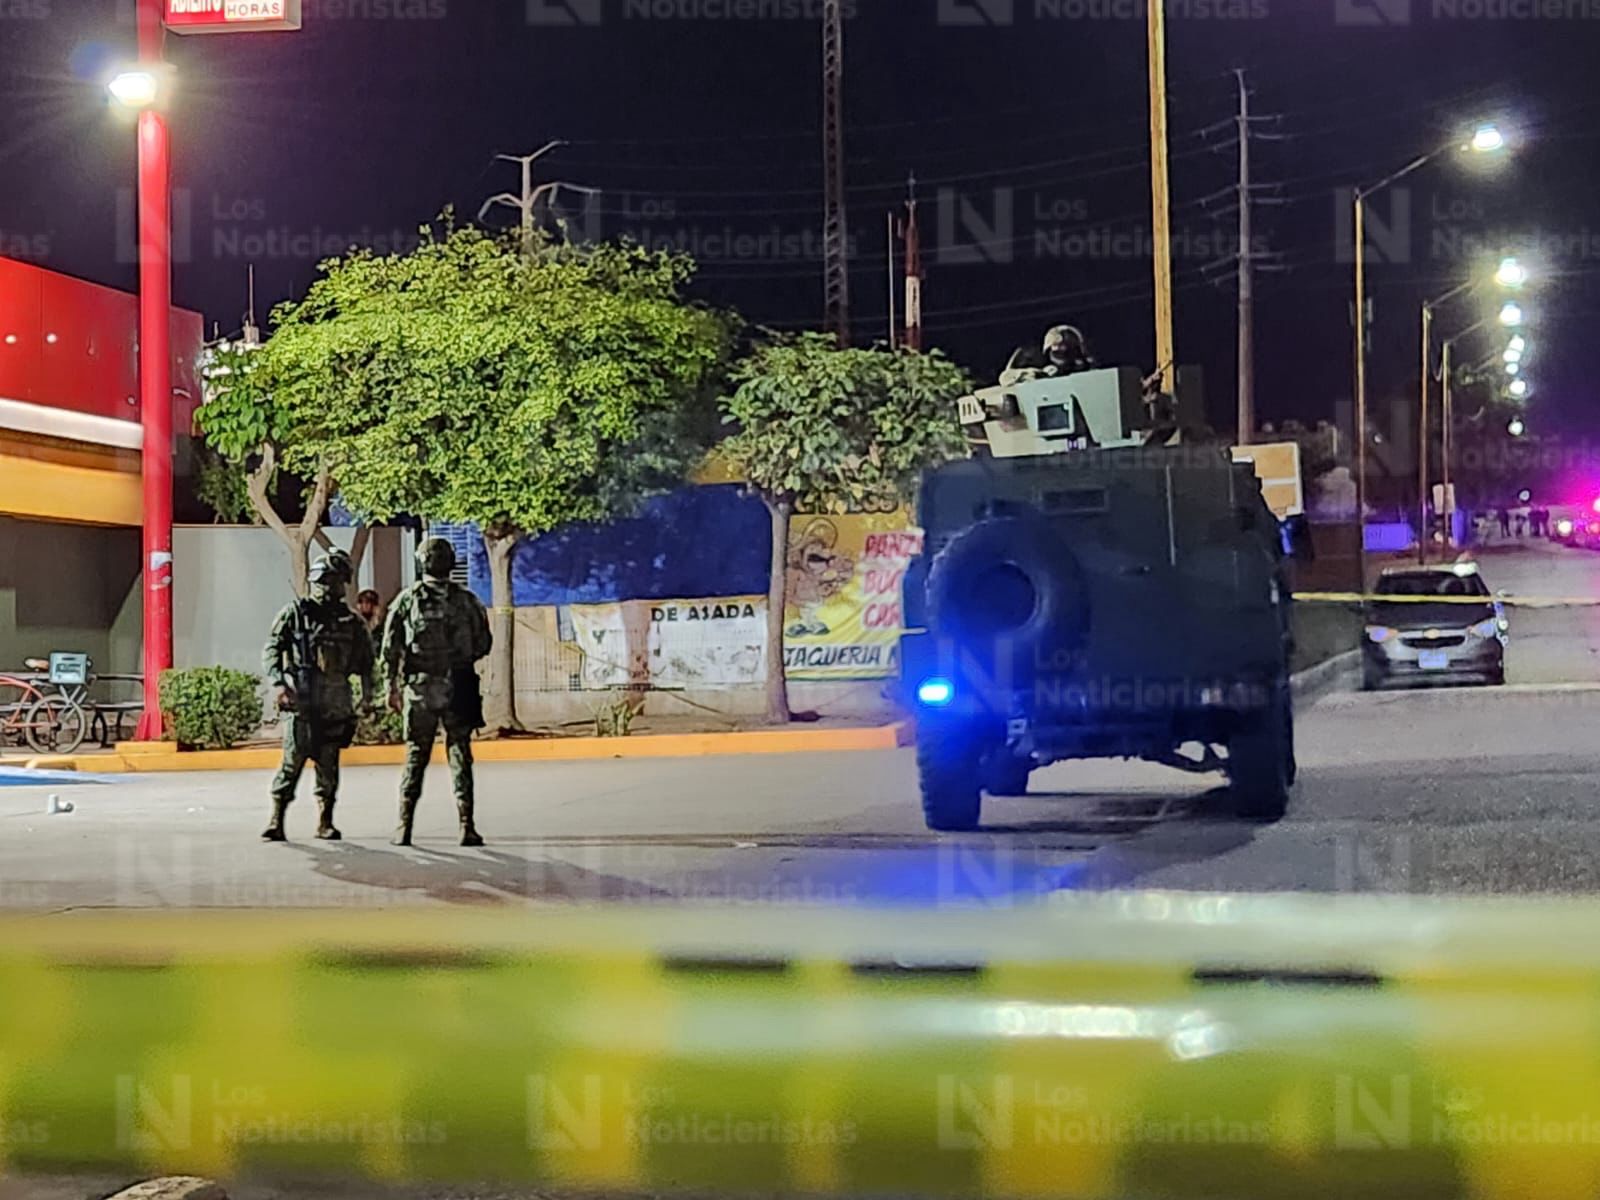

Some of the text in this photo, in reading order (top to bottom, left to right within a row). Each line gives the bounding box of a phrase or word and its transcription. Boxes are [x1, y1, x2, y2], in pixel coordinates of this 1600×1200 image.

[227, 3, 280, 16] HORAS
[651, 604, 755, 621] DE ASADA
